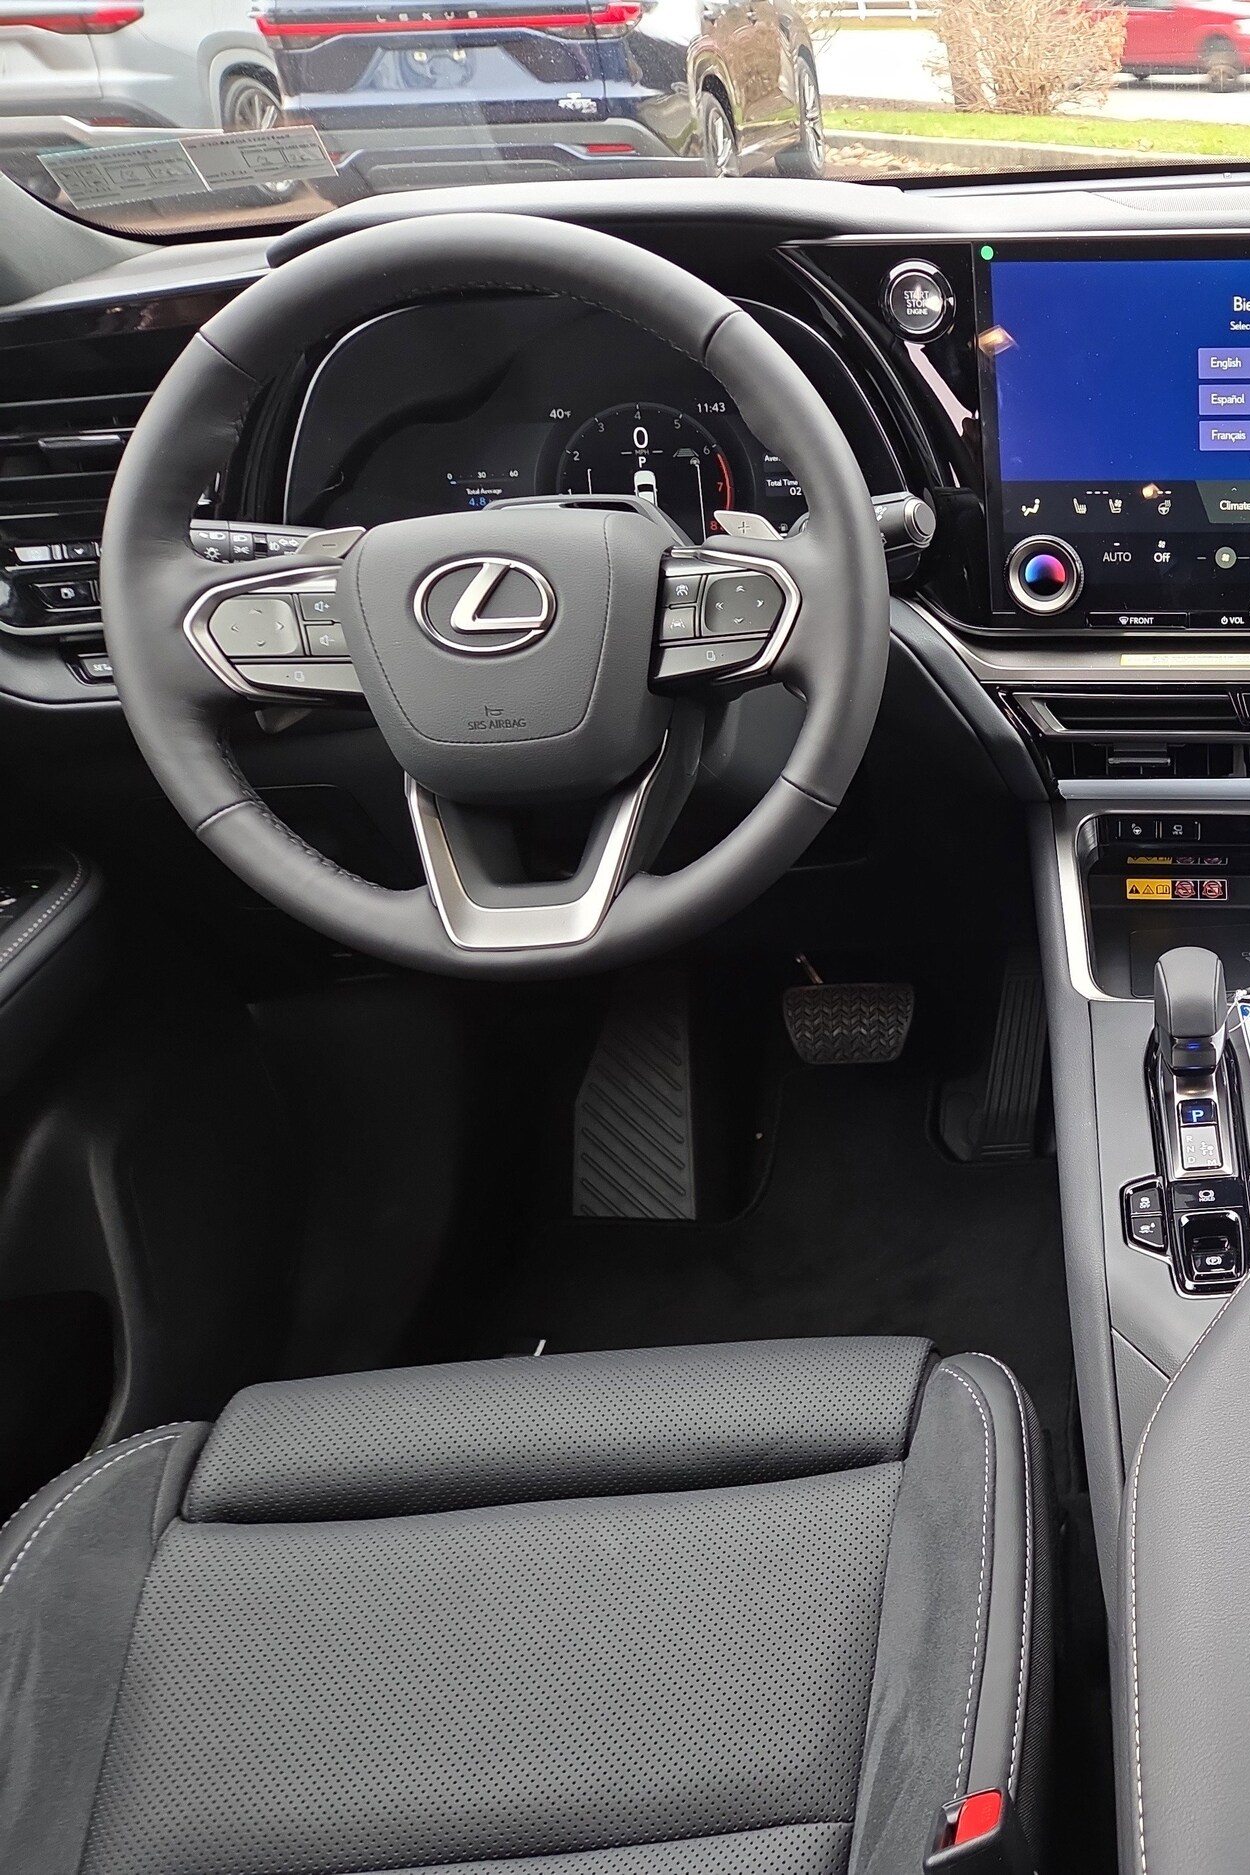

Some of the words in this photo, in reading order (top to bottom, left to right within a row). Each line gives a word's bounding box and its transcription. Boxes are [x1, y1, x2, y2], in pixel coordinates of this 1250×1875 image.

[904, 291, 929, 299] START
[1210, 357, 1242, 370] English
[1211, 393, 1245, 406] Español
[697, 402, 726, 413] 11:43
[634, 411, 642, 420] 4
[597, 423, 605, 433] 3
[673, 420, 681, 429] 5
[633, 426, 649, 449] 0
[1211, 429, 1246, 443] Français
[703, 446, 711, 455] 6
[572, 451, 580, 461] 2
[638, 456, 647, 468] P
[446, 472, 453, 480] 0
[477, 471, 487, 479] 30
[716, 482, 723, 492] 7
[766, 479, 782, 487] Total
[480, 487, 503, 495] Average
[789, 486, 802, 496] 02
[469, 497, 486, 506] 4.8
[1103, 552, 1131, 562] AUTO
[1153, 552, 1171, 562] Off
[468, 720, 487, 730] SRS
[489, 718, 527, 729] AIRBAG
[1192, 1109, 1204, 1122] P
[1186, 1135, 1193, 1143] R
[1188, 1156, 1196, 1164] D
[1207, 1158, 1217, 1166] M
